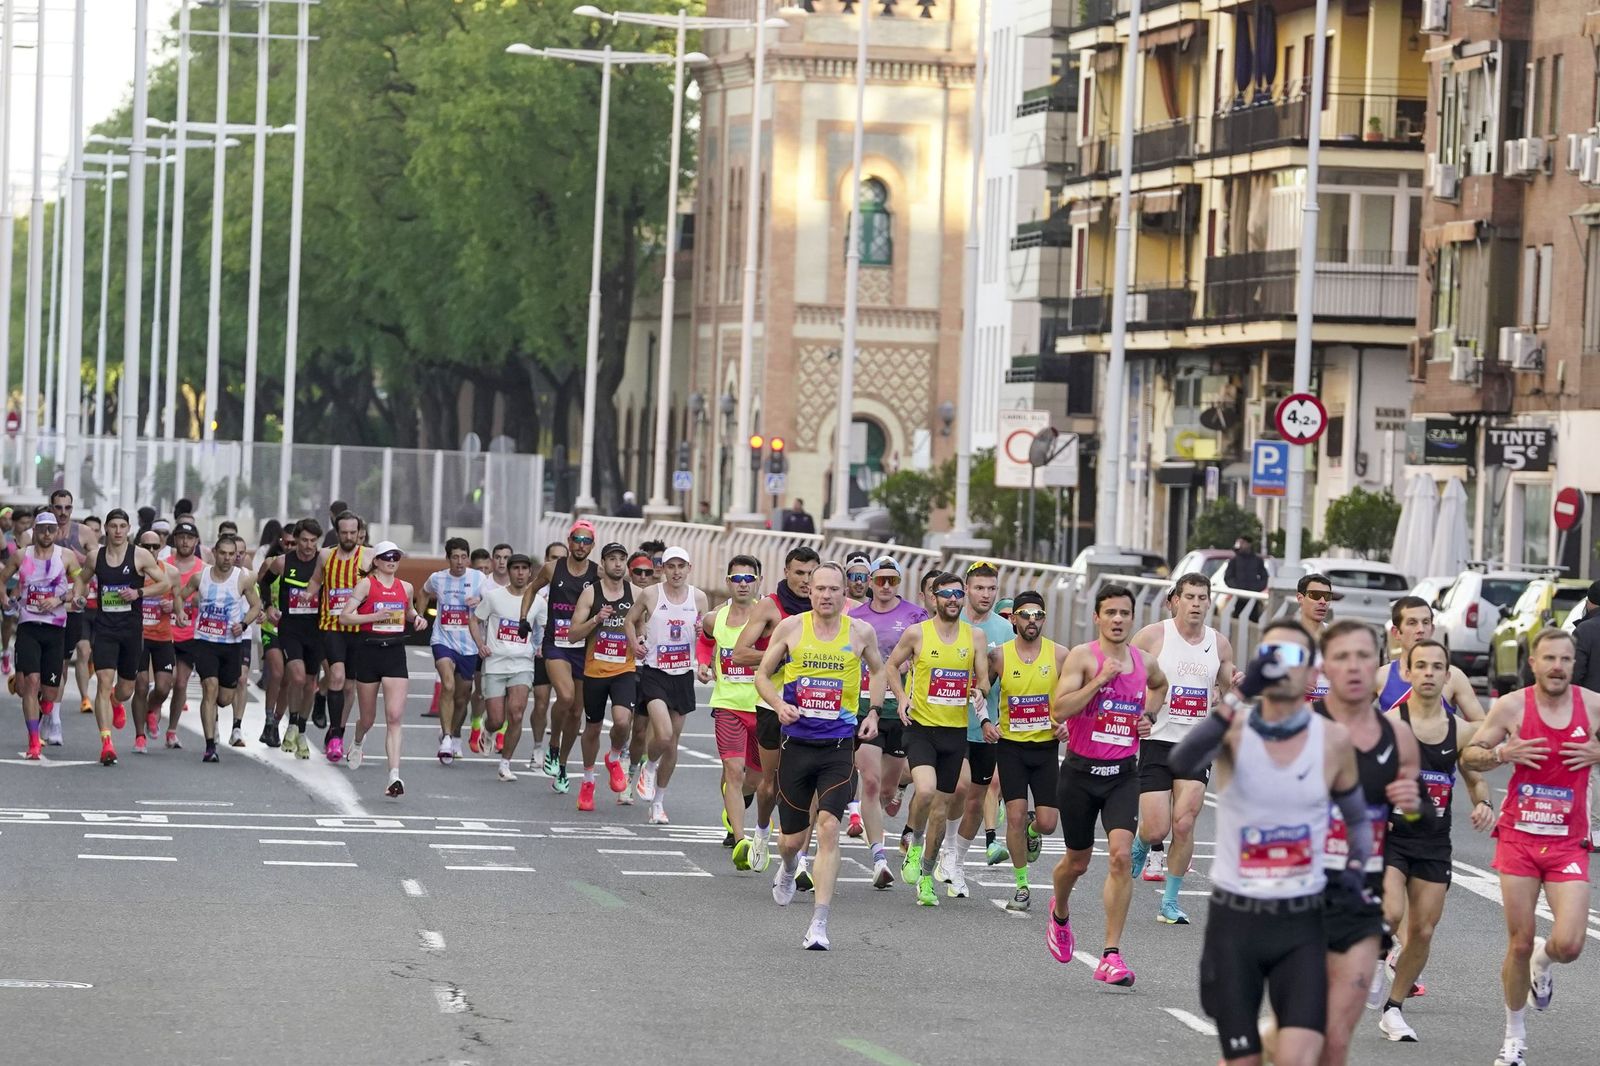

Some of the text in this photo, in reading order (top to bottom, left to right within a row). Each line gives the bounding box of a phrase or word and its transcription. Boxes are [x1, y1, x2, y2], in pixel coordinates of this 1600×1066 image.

[1488, 429, 1546, 446] TINTE
[1256, 446, 1280, 475] P
[1502, 445, 1539, 470] 5€
[604, 648, 618, 656] TOM
[802, 652, 845, 662] ST ALBANS
[672, 661, 691, 669] MORET
[802, 661, 845, 671] STRIDERS
[727, 667, 745, 675] RUBI
[812, 680, 838, 688] ZURICH
[936, 688, 961, 697] AZUAR
[801, 698, 836, 710] PATRICK
[1114, 703, 1137, 712] ZURICH
[1169, 707, 1192, 716] CHARLY
[1104, 723, 1131, 736] DAVID
[1536, 787, 1567, 798] ZURICH
[1520, 810, 1564, 824] THOMAS
